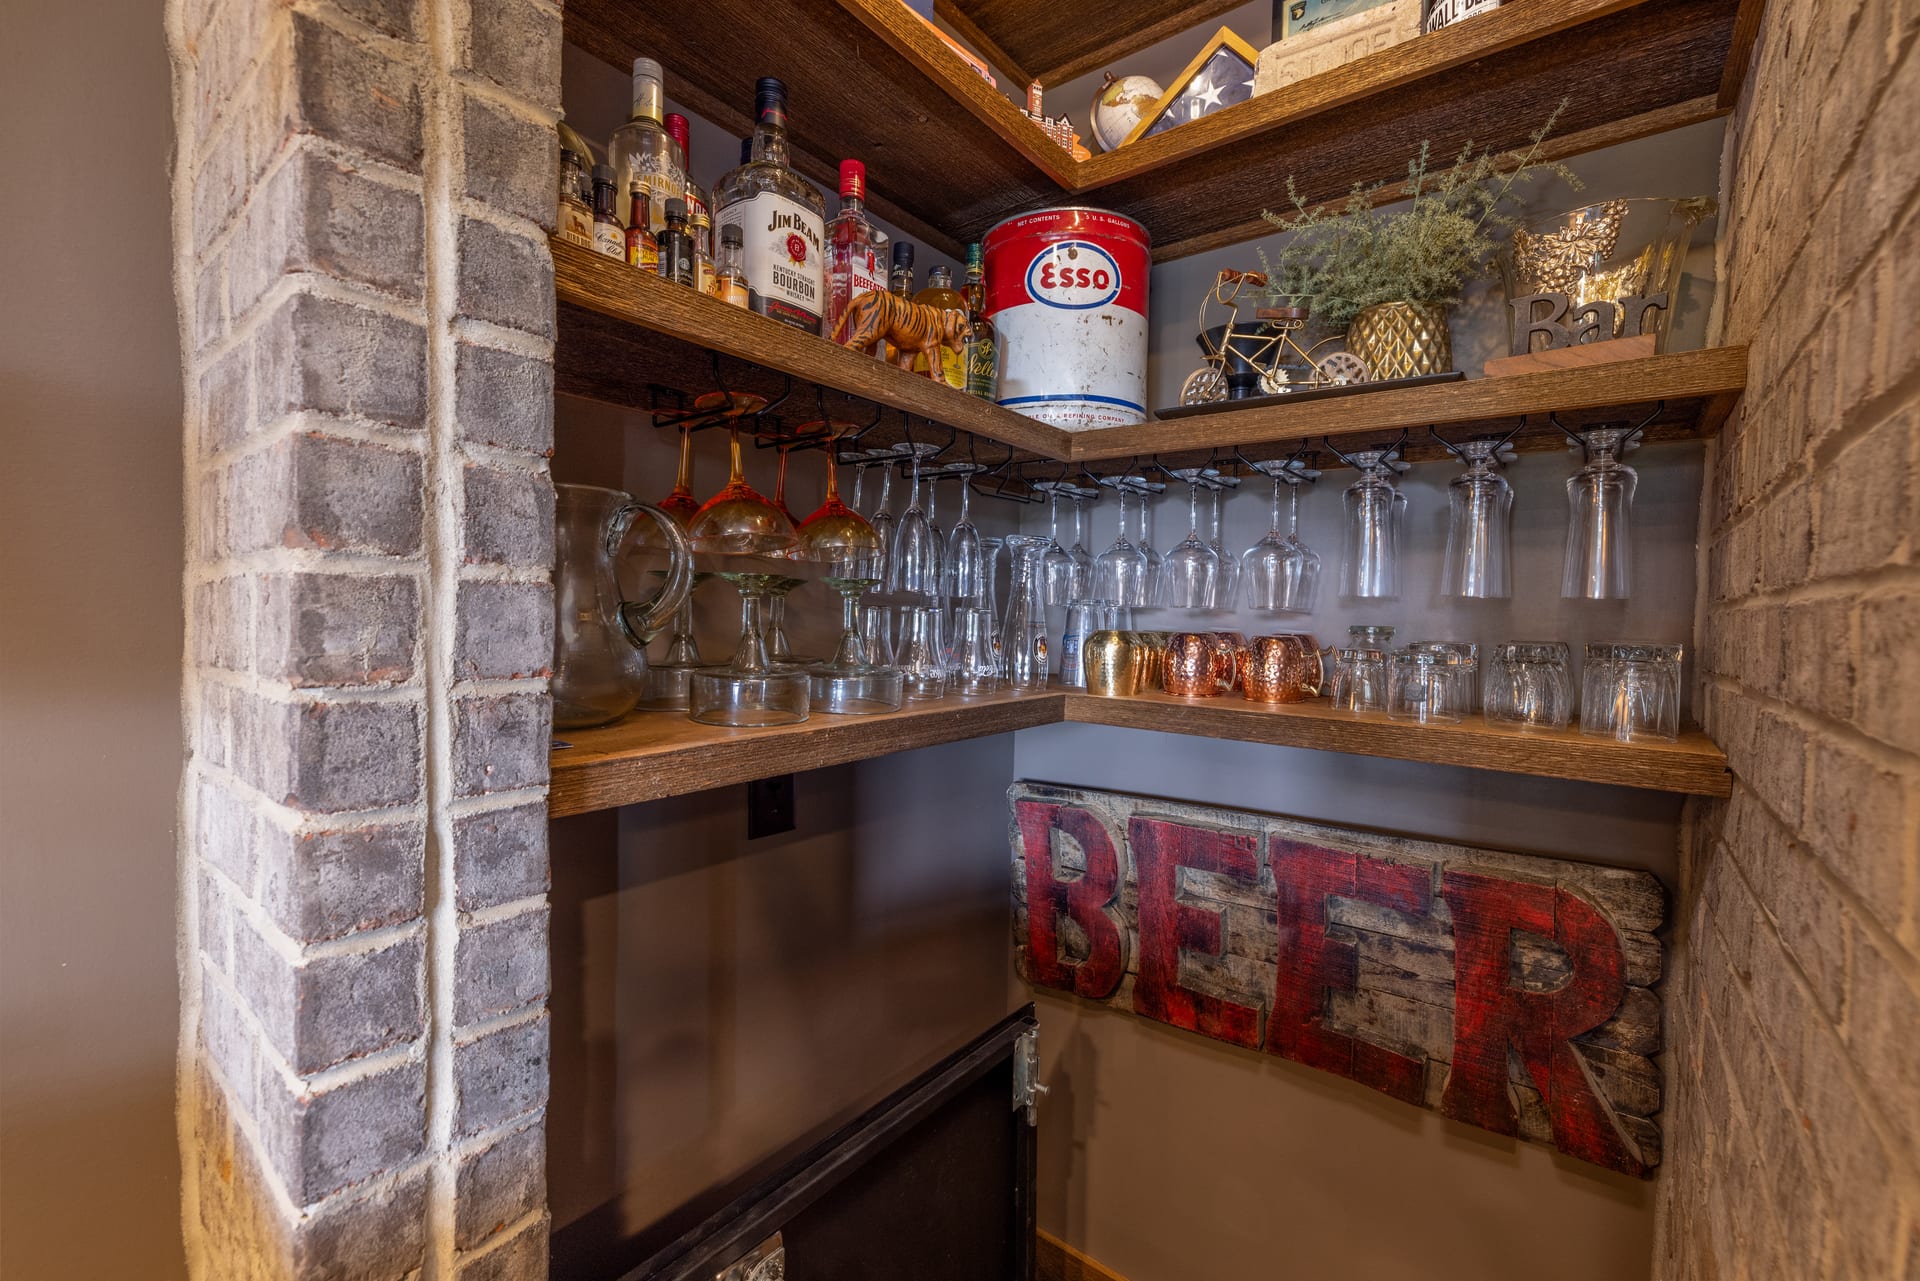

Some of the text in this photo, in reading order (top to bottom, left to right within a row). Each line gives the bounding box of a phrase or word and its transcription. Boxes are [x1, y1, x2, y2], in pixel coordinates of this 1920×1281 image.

[767, 210, 792, 232] JIM
[793, 213, 820, 252] BEAM
[1028, 214, 1061, 224] CONTENTS
[1107, 217, 1131, 229] GALLONS
[772, 264, 815, 285] KENTUCKY STRAIGHT
[772, 271, 815, 300] BOURBON
[1509, 292, 1668, 357] Bar
[1098, 414, 1125, 423] COMPANY
[1015, 797, 1647, 1178] BEER
